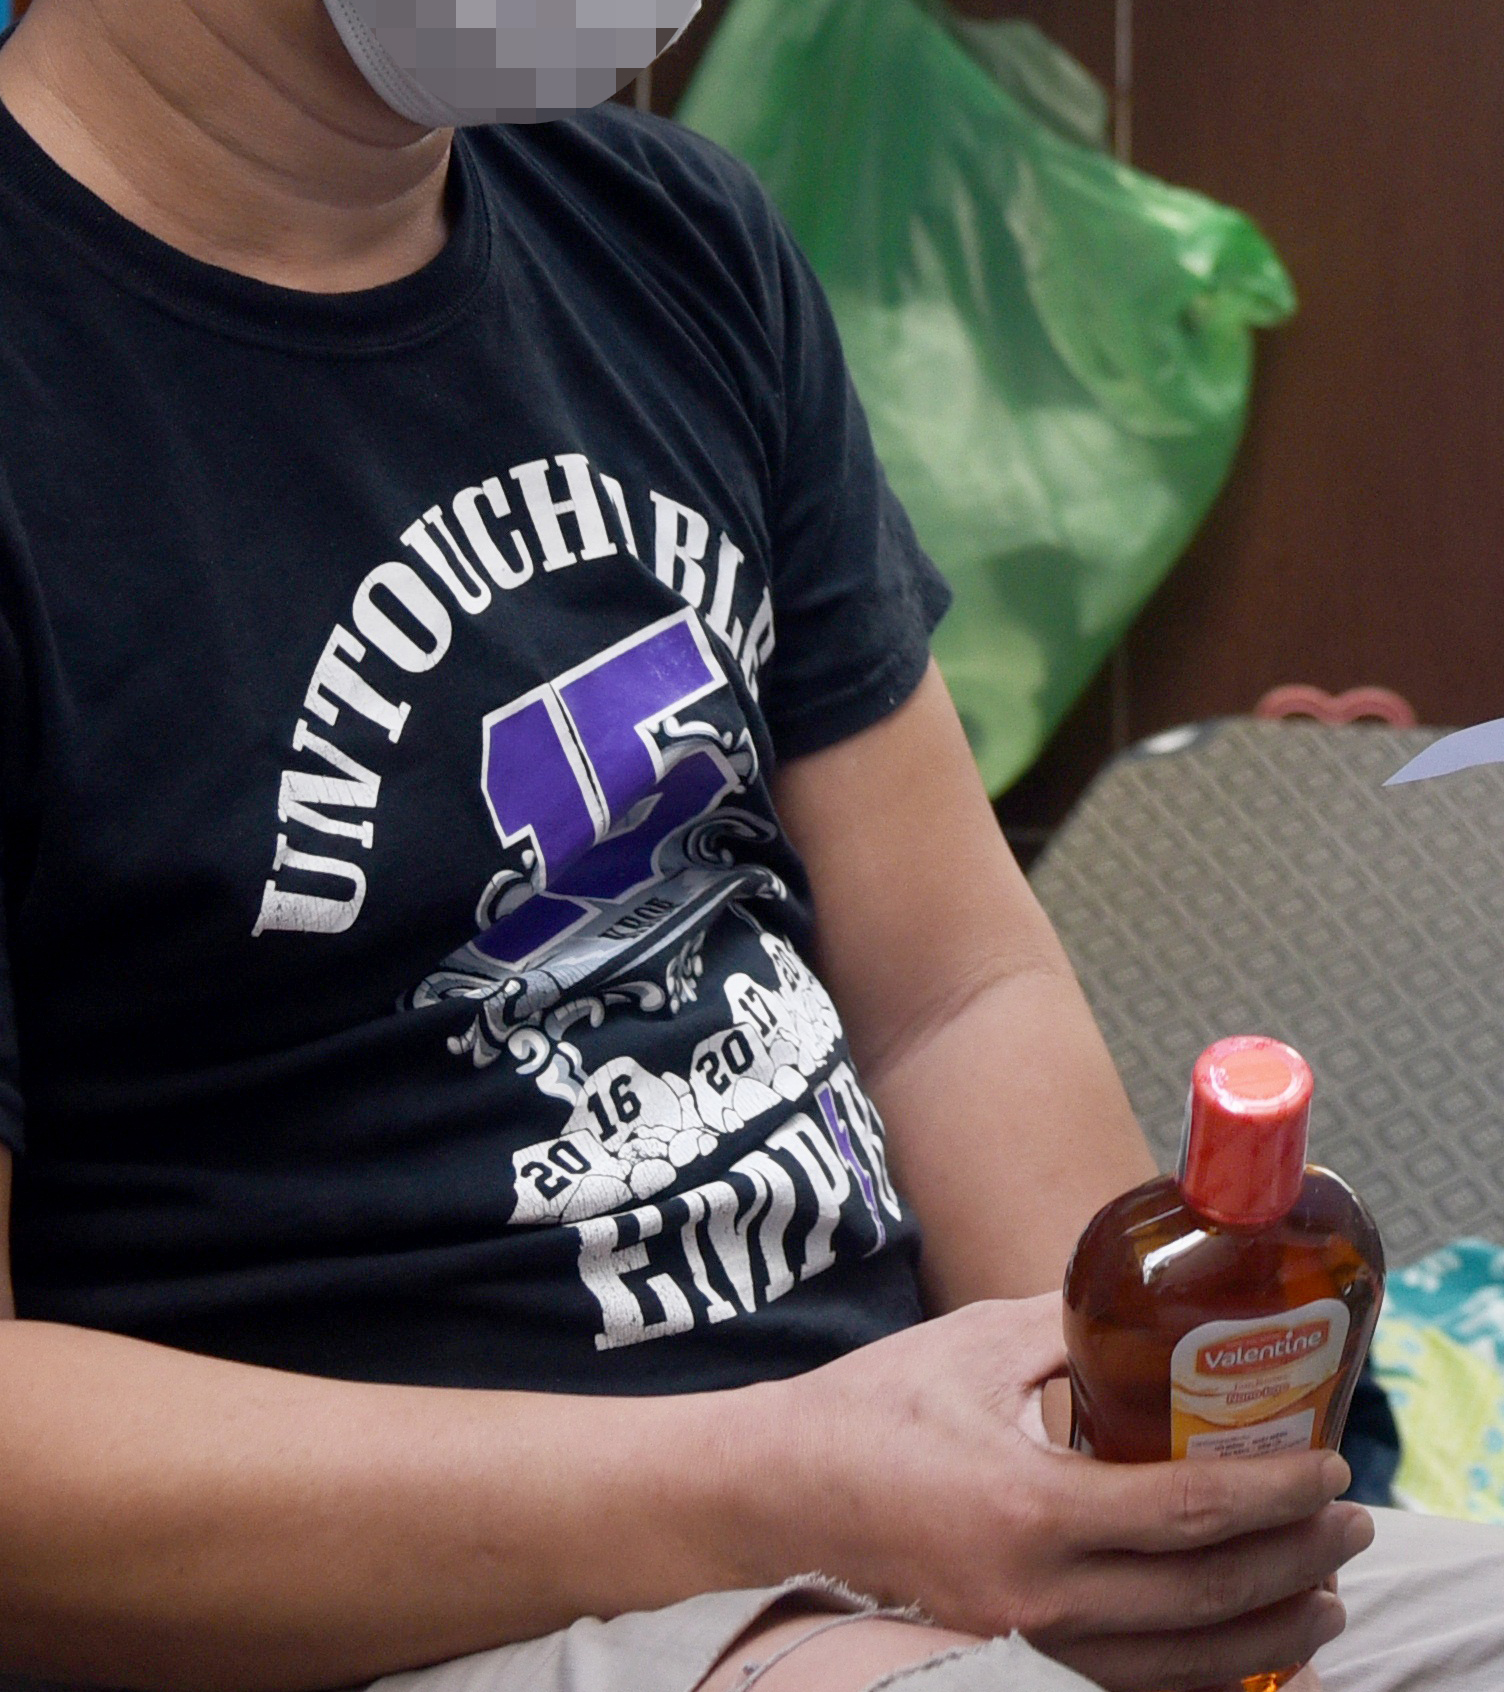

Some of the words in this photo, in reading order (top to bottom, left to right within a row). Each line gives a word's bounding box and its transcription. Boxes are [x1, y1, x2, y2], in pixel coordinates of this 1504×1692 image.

[697, 1029, 754, 1094] 20
[738, 985, 778, 1038] 17
[520, 1140, 592, 1200] 20
[587, 1074, 642, 1142] 16
[1204, 1329, 1323, 1369] Valentine
